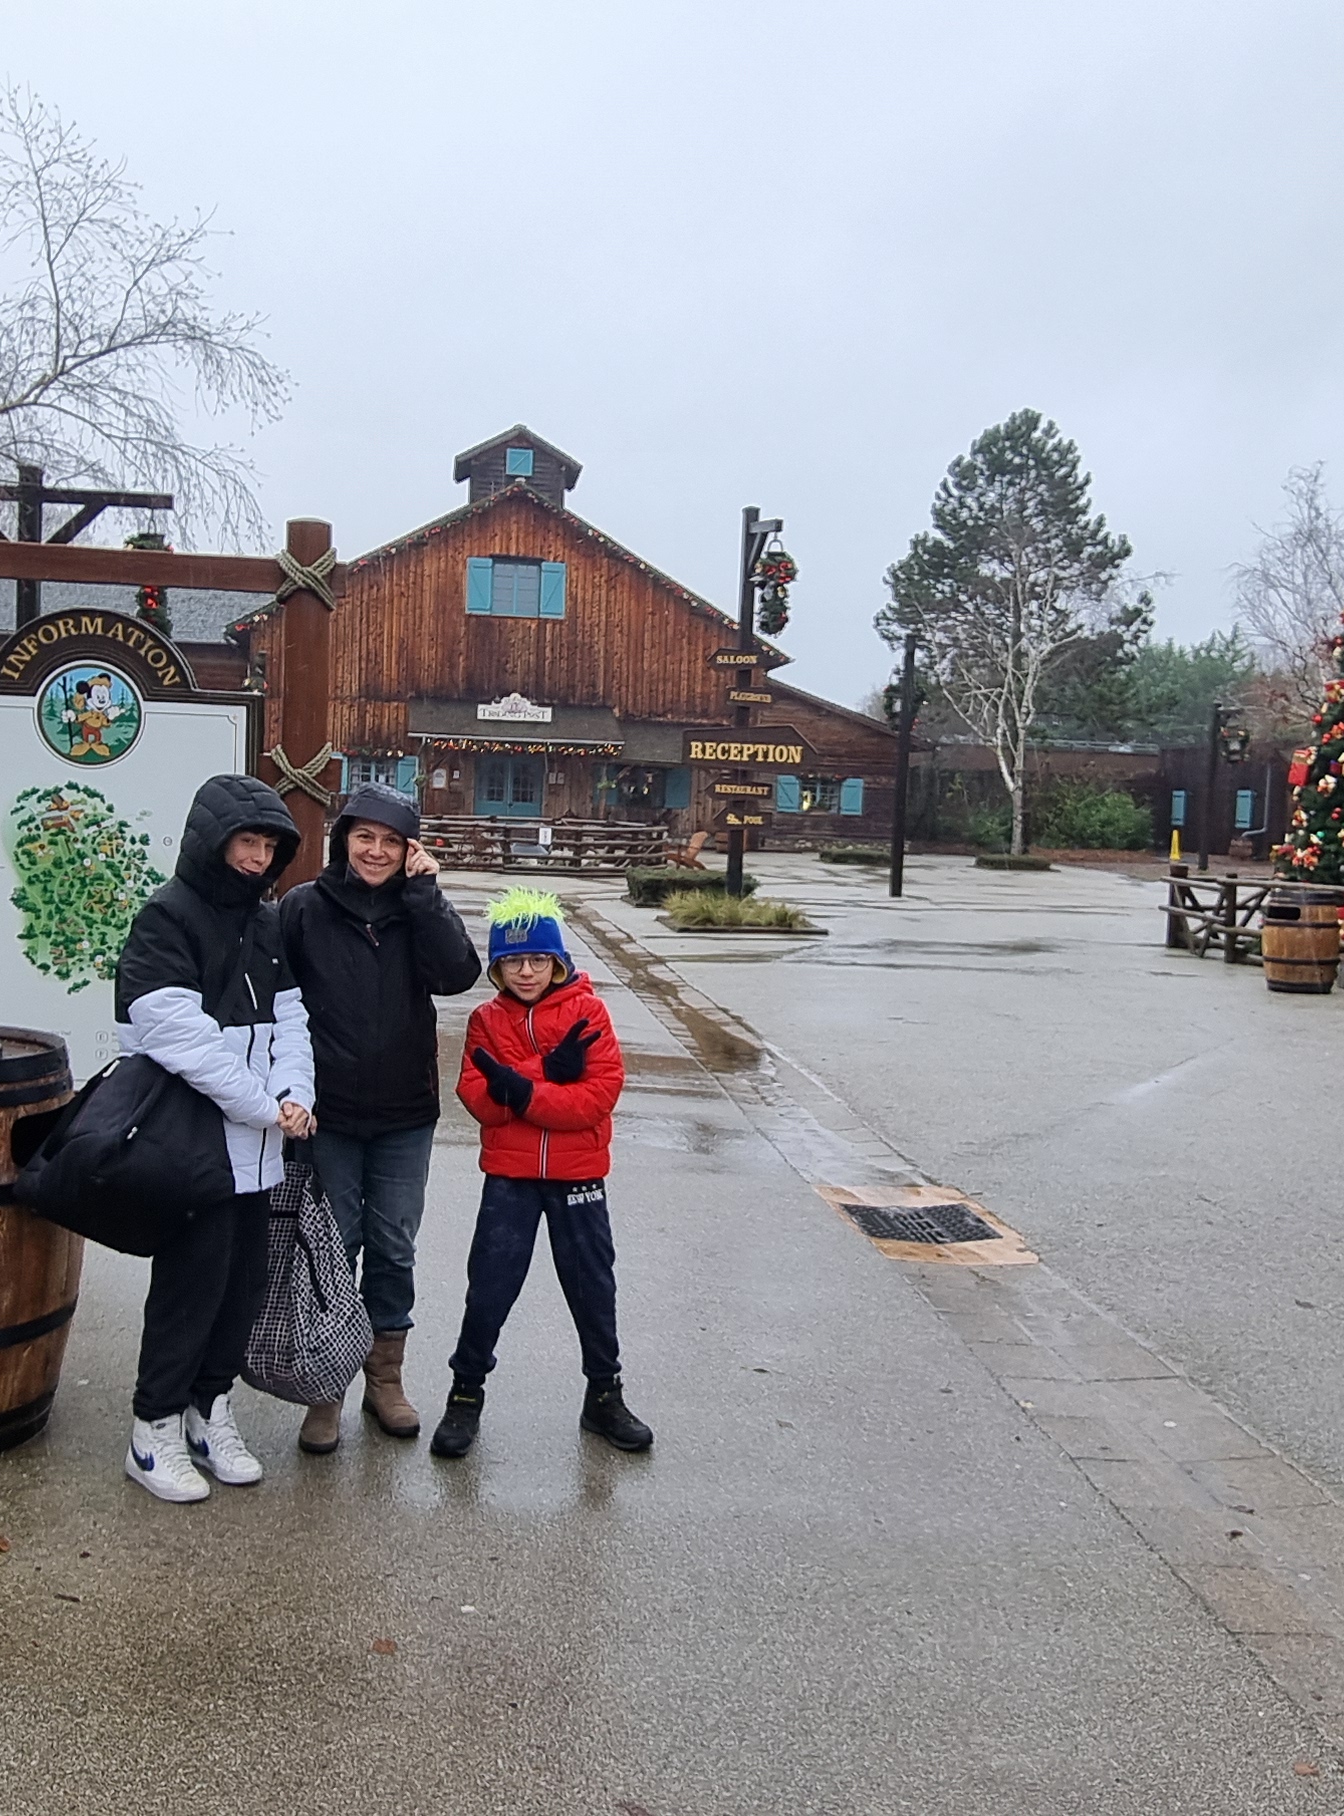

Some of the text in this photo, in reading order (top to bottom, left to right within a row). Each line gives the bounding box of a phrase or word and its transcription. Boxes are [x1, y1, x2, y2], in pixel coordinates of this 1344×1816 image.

[0, 615, 182, 686] INFORMATION
[716, 655, 757, 664] SALOON
[690, 741, 803, 763] RECEPTION
[715, 784, 770, 795] RESTAURANT
